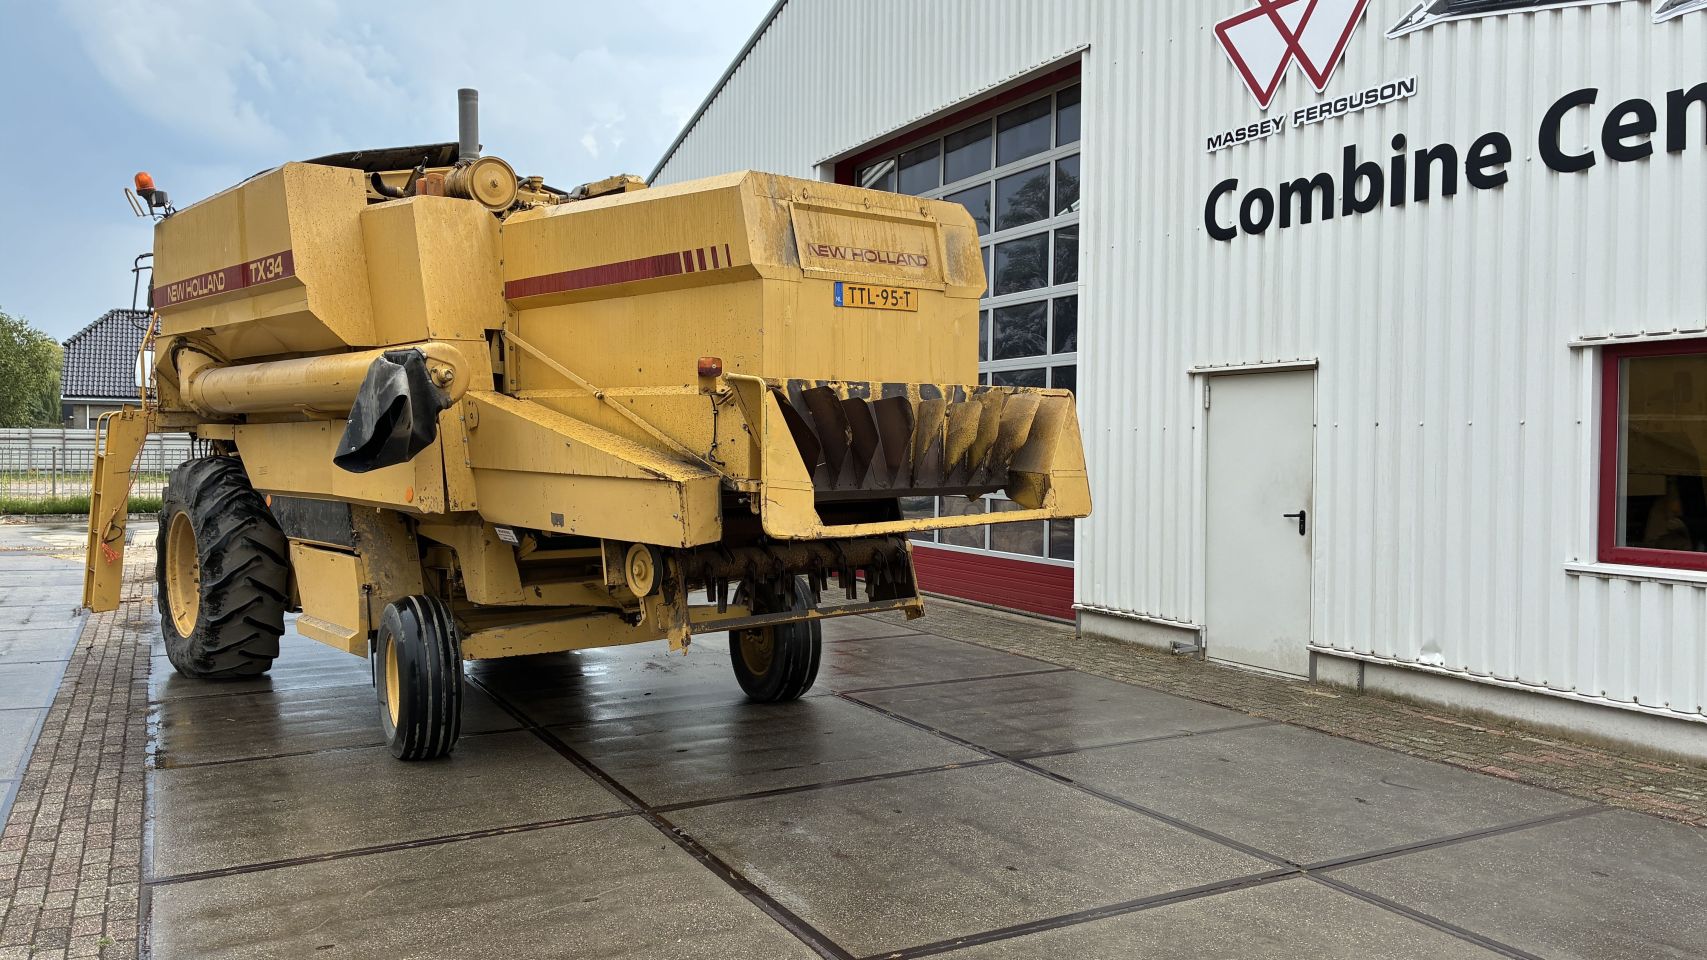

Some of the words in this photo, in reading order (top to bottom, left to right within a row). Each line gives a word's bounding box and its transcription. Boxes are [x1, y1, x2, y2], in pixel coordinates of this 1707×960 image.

[1207, 115, 1285, 150] MASSEY
[1294, 77, 1415, 125] FERGUSON
[1204, 131, 1512, 241] Combine
[807, 243, 846, 260] NEW
[852, 249, 928, 267] HOLLAND
[167, 282, 185, 303] NEW
[186, 271, 225, 298] HOLLAND
[848, 286, 911, 308] TTL-95-T
